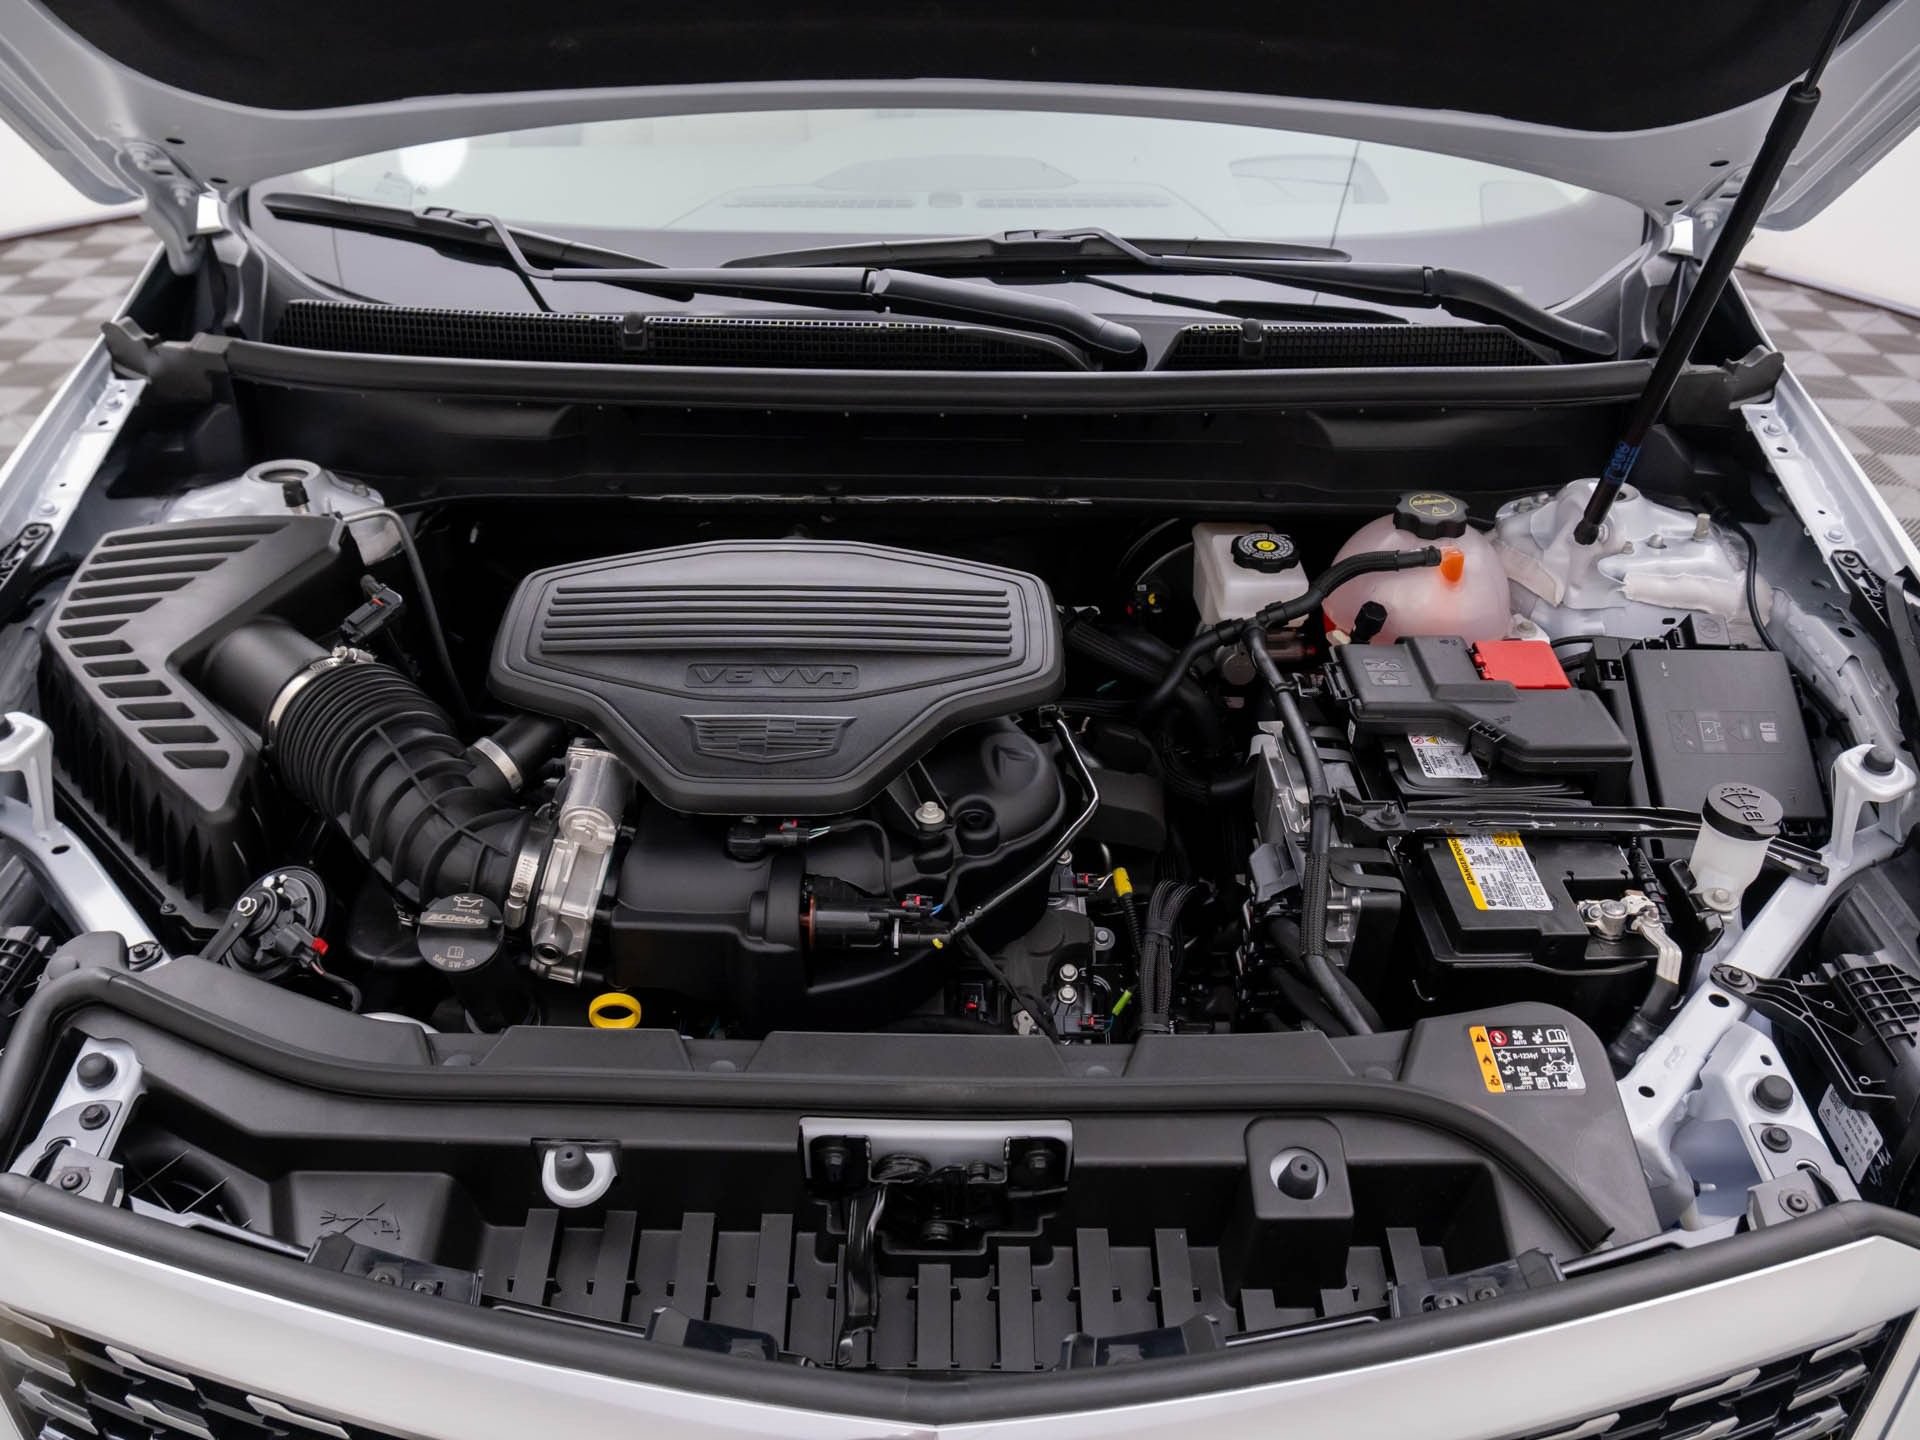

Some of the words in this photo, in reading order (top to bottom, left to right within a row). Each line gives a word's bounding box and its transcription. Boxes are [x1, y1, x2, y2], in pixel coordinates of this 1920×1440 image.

[692, 666, 753, 684] V6
[763, 666, 853, 685] VVT
[427, 913, 485, 925] ACDelco
